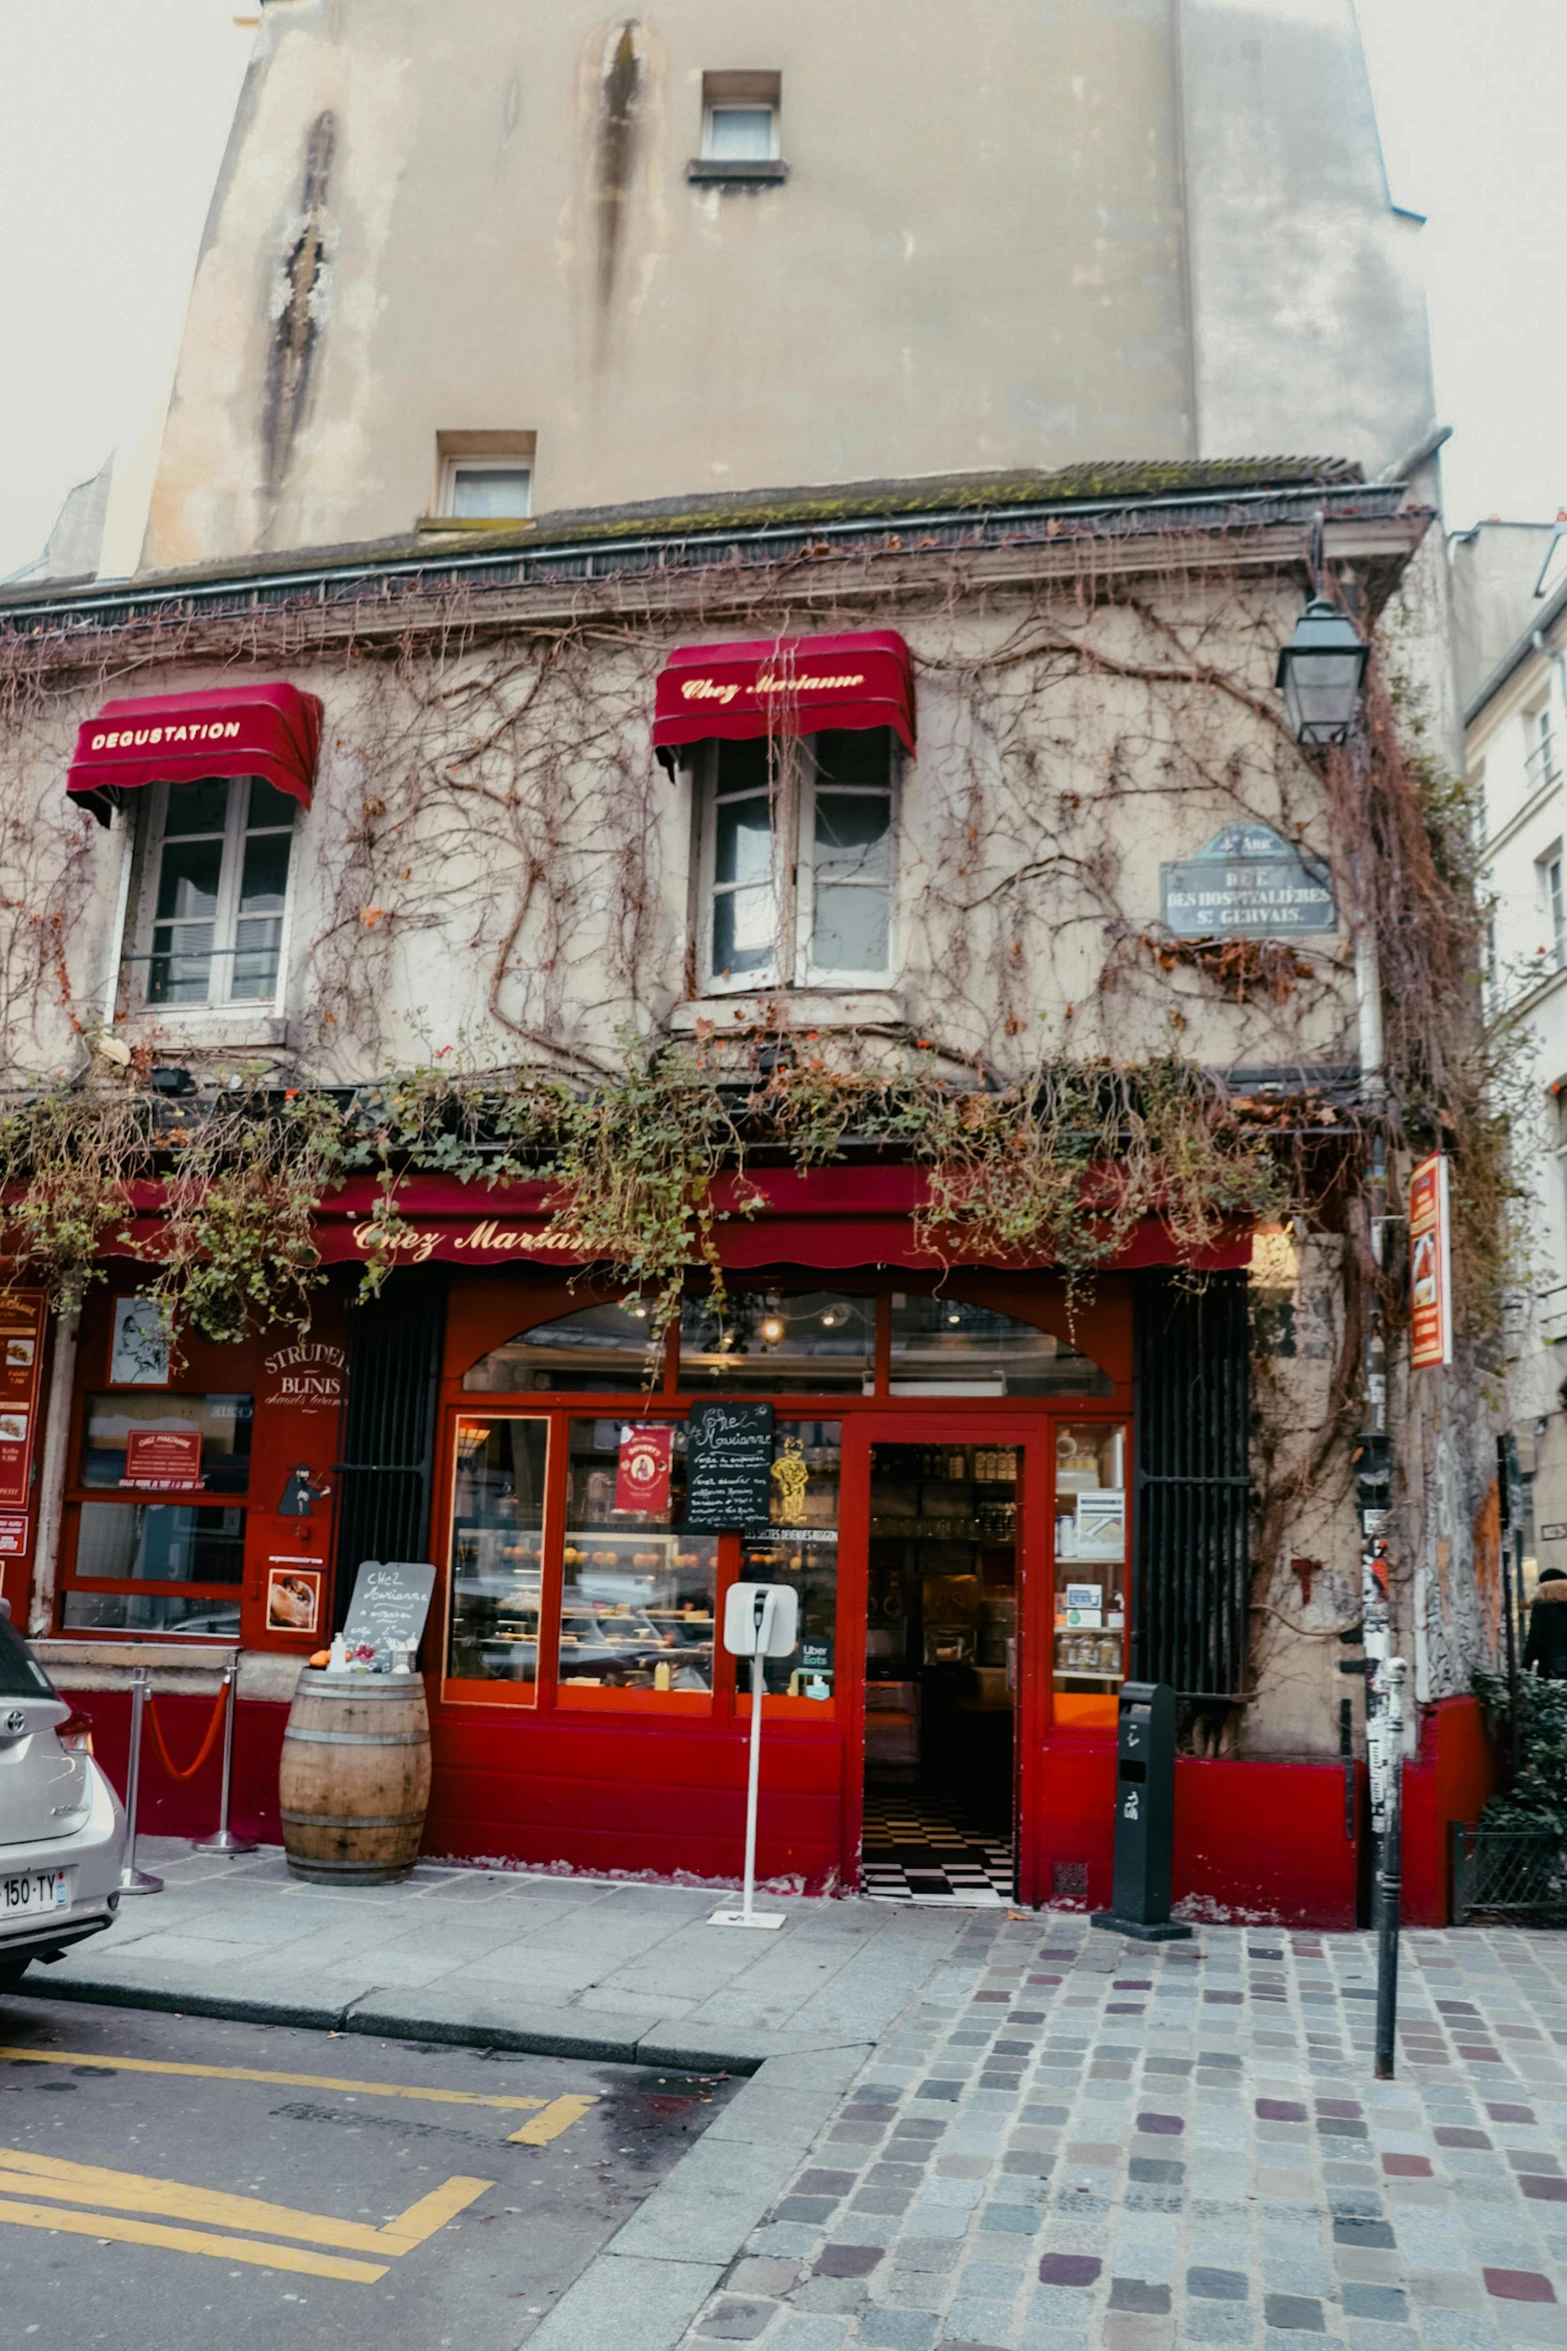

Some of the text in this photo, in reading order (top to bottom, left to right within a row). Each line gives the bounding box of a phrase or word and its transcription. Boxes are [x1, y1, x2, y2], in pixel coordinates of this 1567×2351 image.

[681, 673, 865, 705] Chez Marianne
[91, 722, 241, 750] DEGUSTATION
[1167, 893, 1196, 908] DES
[281, 1377, 341, 1395] BLINIS
[803, 1645, 828, 1656] Uber
[803, 1655, 828, 1665] Eats
